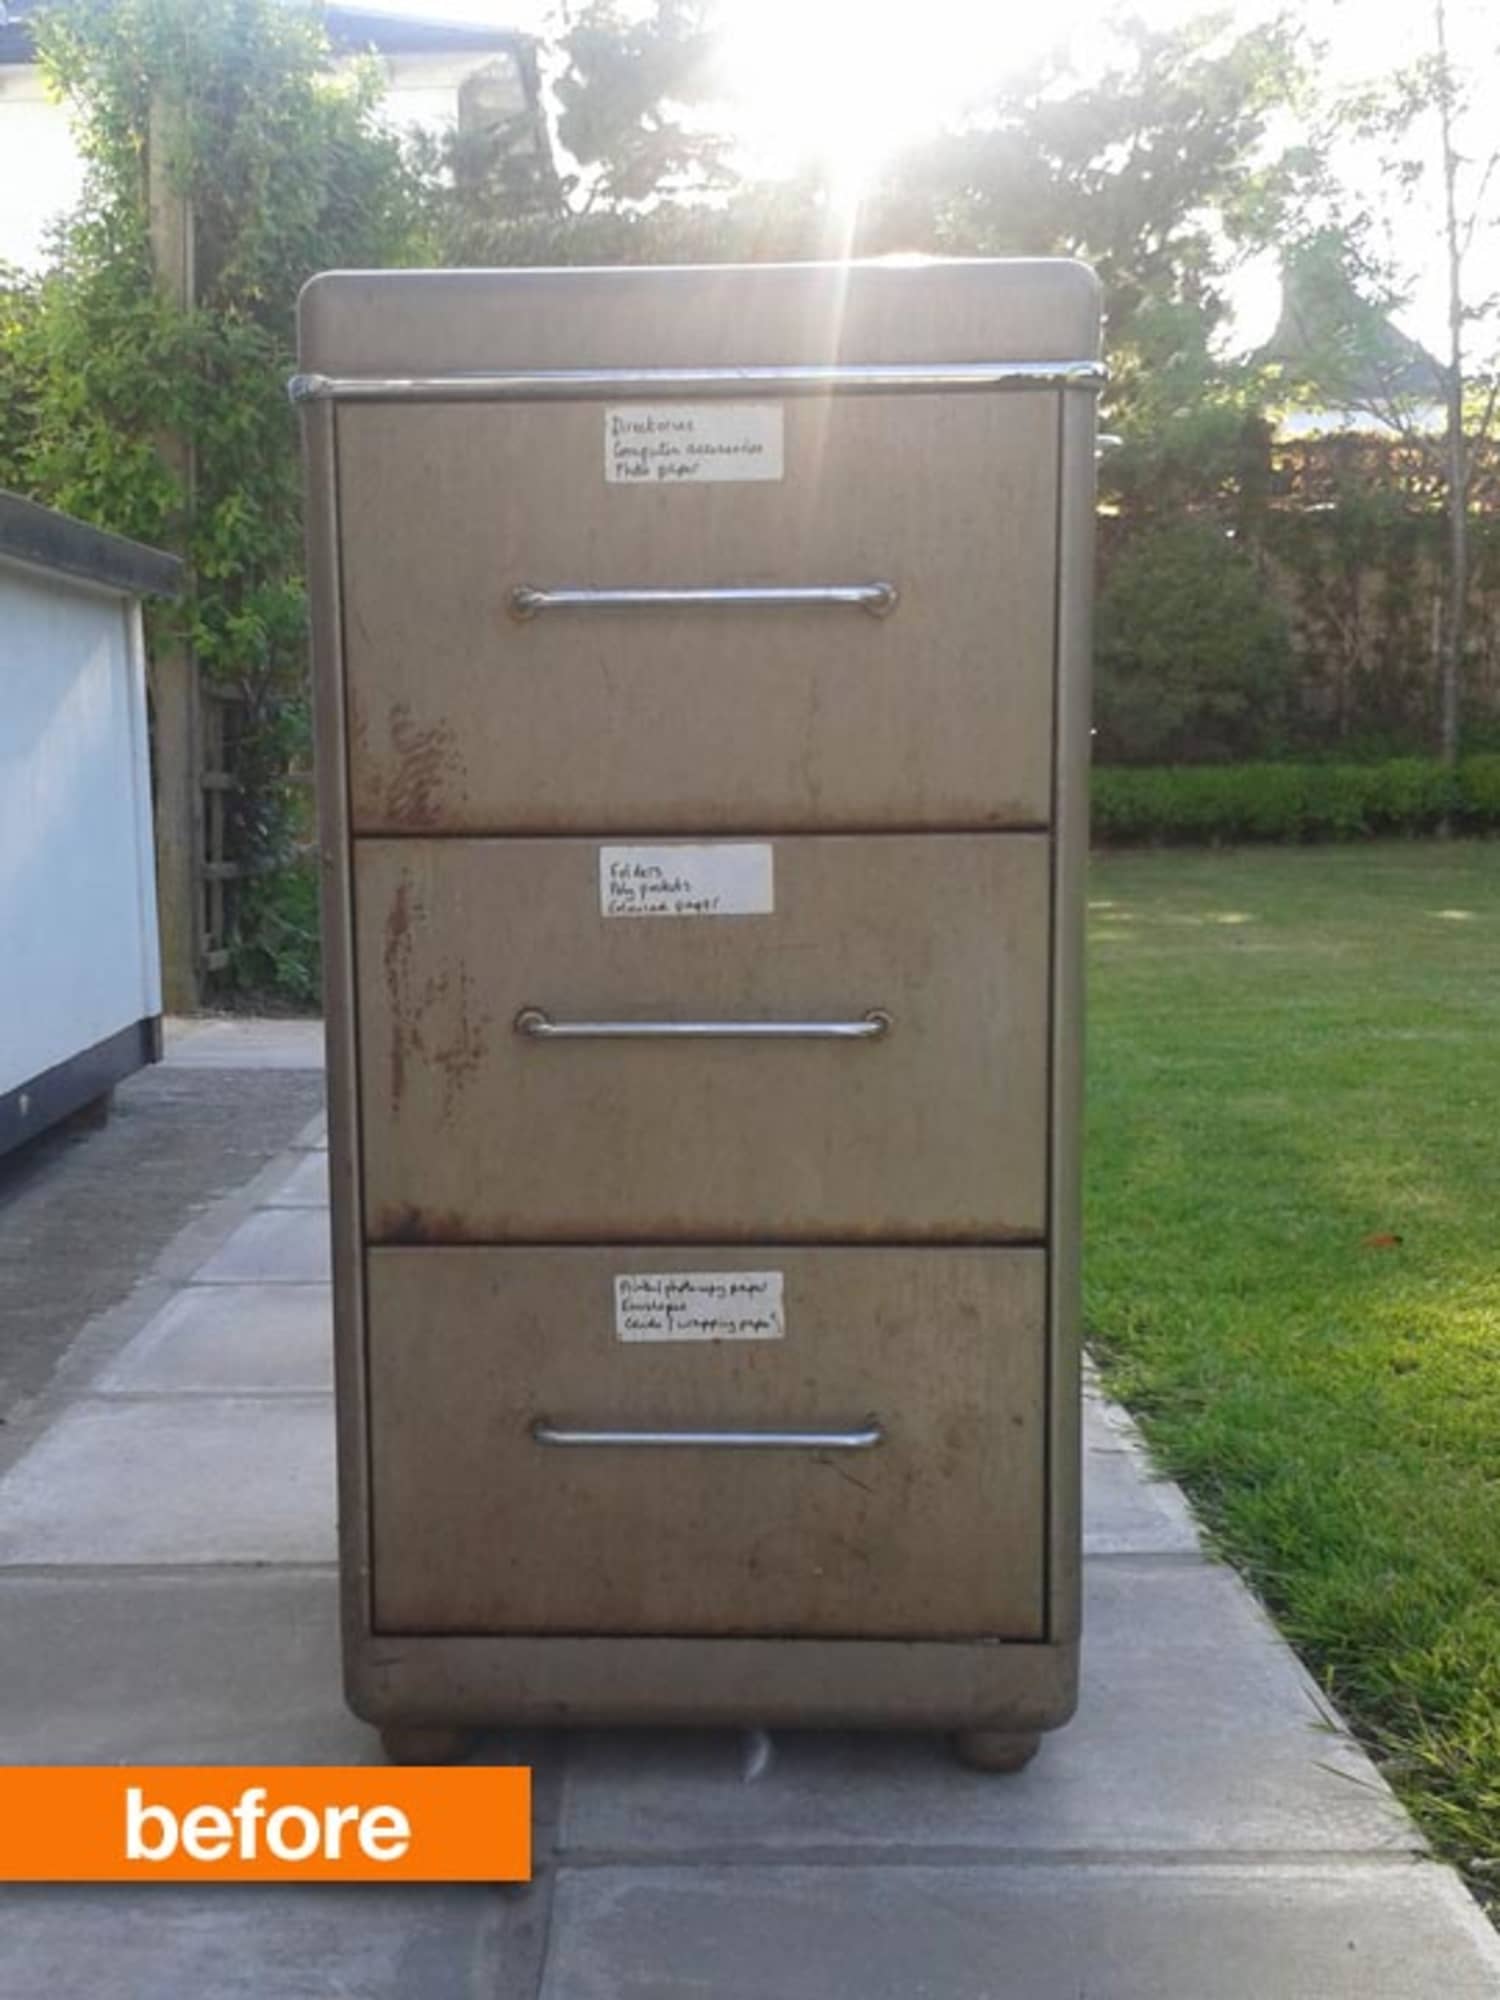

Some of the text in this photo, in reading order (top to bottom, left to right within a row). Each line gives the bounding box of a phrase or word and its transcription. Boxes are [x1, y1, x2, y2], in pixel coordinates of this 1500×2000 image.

[614, 441, 681, 465] Computer
[658, 463, 699, 480] paper
[610, 863, 662, 879] Folders
[622, 1300, 686, 1316] Envelopes
